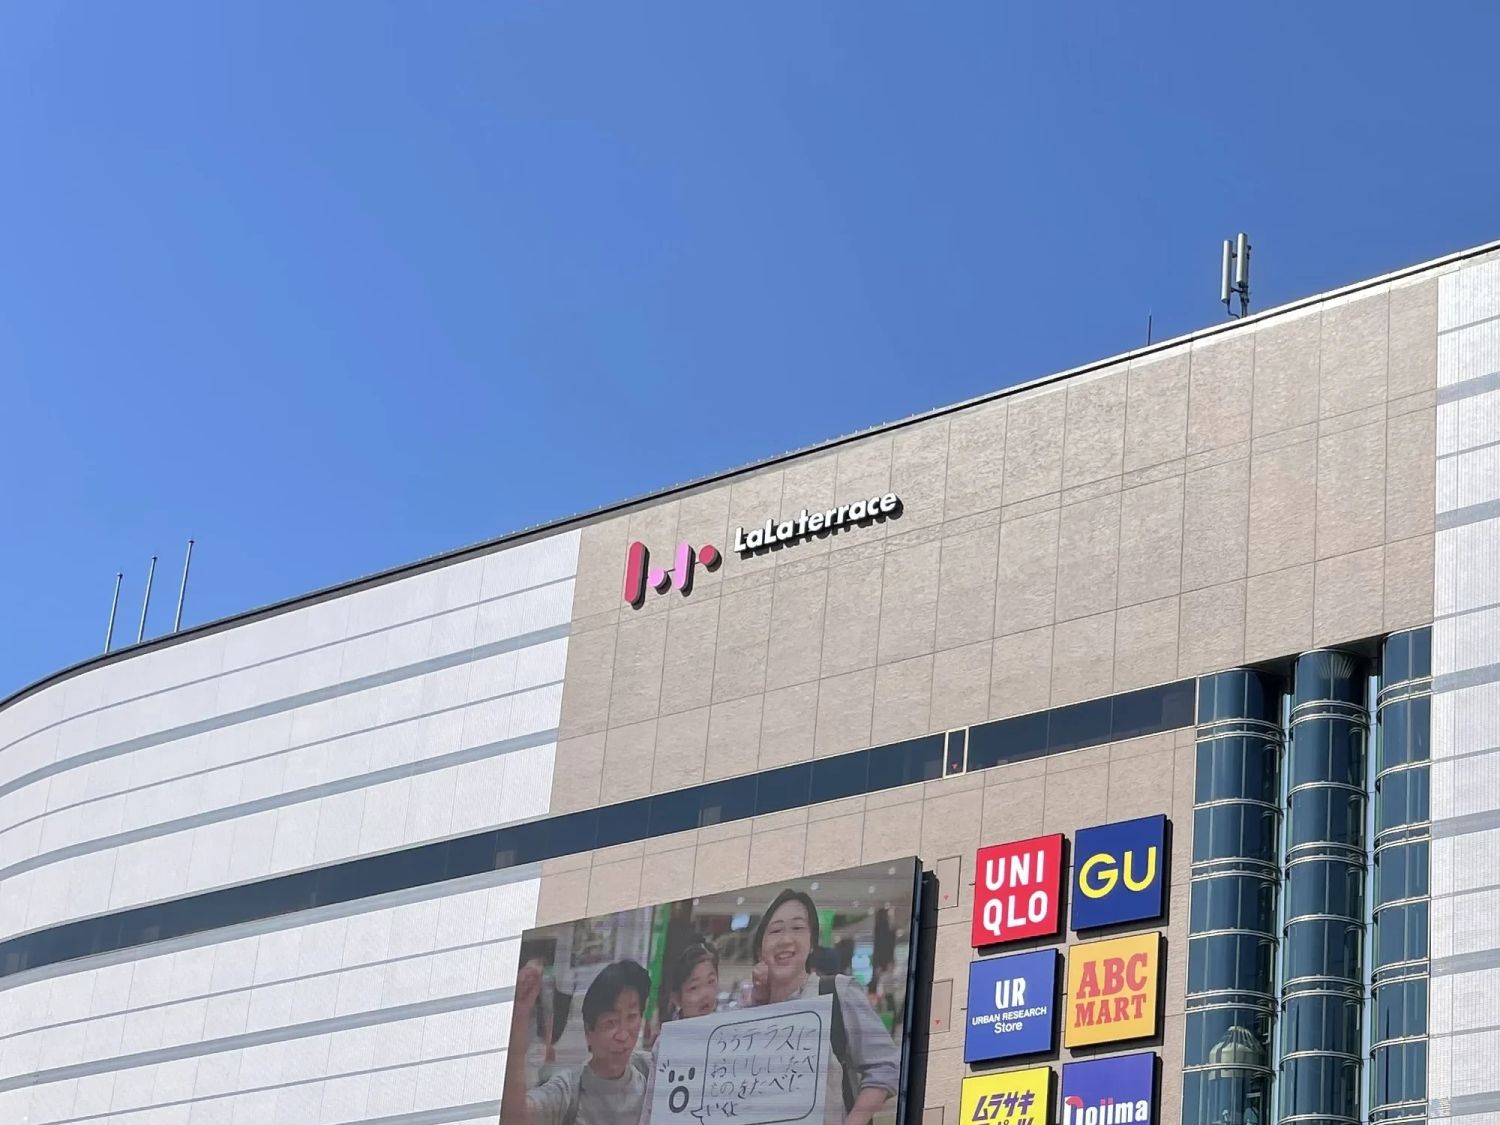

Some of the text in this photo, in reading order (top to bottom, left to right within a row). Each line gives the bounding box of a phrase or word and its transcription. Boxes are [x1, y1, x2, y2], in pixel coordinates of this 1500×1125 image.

[796, 492, 898, 536] terrace
[984, 850, 1045, 891] UNI
[1078, 846, 1157, 899] GU
[982, 890, 1048, 936] QLO
[994, 977, 1027, 1010] UR
[1076, 952, 1148, 999] ABC
[972, 1006, 1047, 1026] URBAN RESEARCH
[994, 1020, 1023, 1034] Store
[1074, 994, 1147, 1028] MART
[971, 1089, 1035, 1122] ムラサキ
